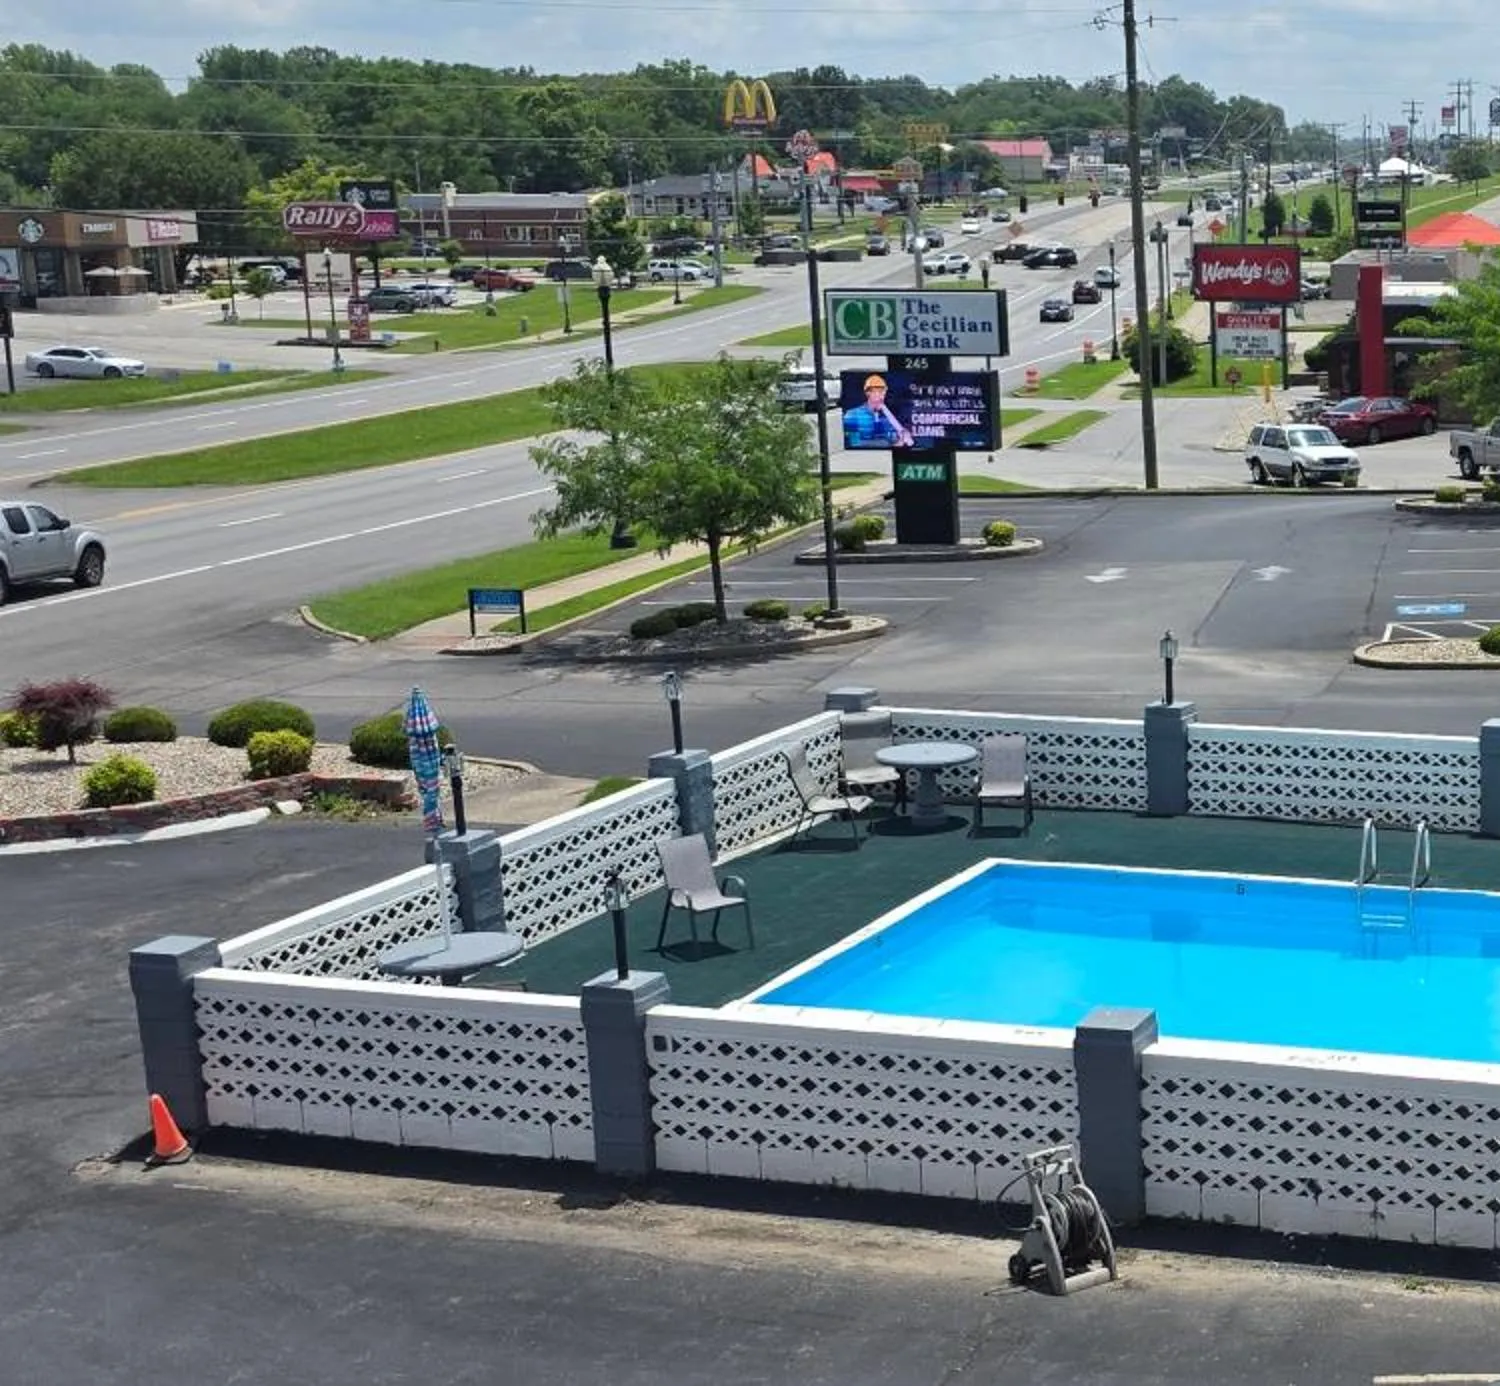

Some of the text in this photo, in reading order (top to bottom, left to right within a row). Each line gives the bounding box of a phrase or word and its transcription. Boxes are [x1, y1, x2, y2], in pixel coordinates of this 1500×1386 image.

[288, 207, 359, 229] Rally's
[1202, 258, 1262, 285] Wendy's
[902, 298, 941, 315] The
[835, 299, 895, 339] CB
[903, 316, 993, 333] Cecilian
[905, 334, 960, 349] Bank
[904, 357, 929, 369] 245
[911, 413, 981, 425] COMMERCIAL
[903, 464, 943, 481] ATM
